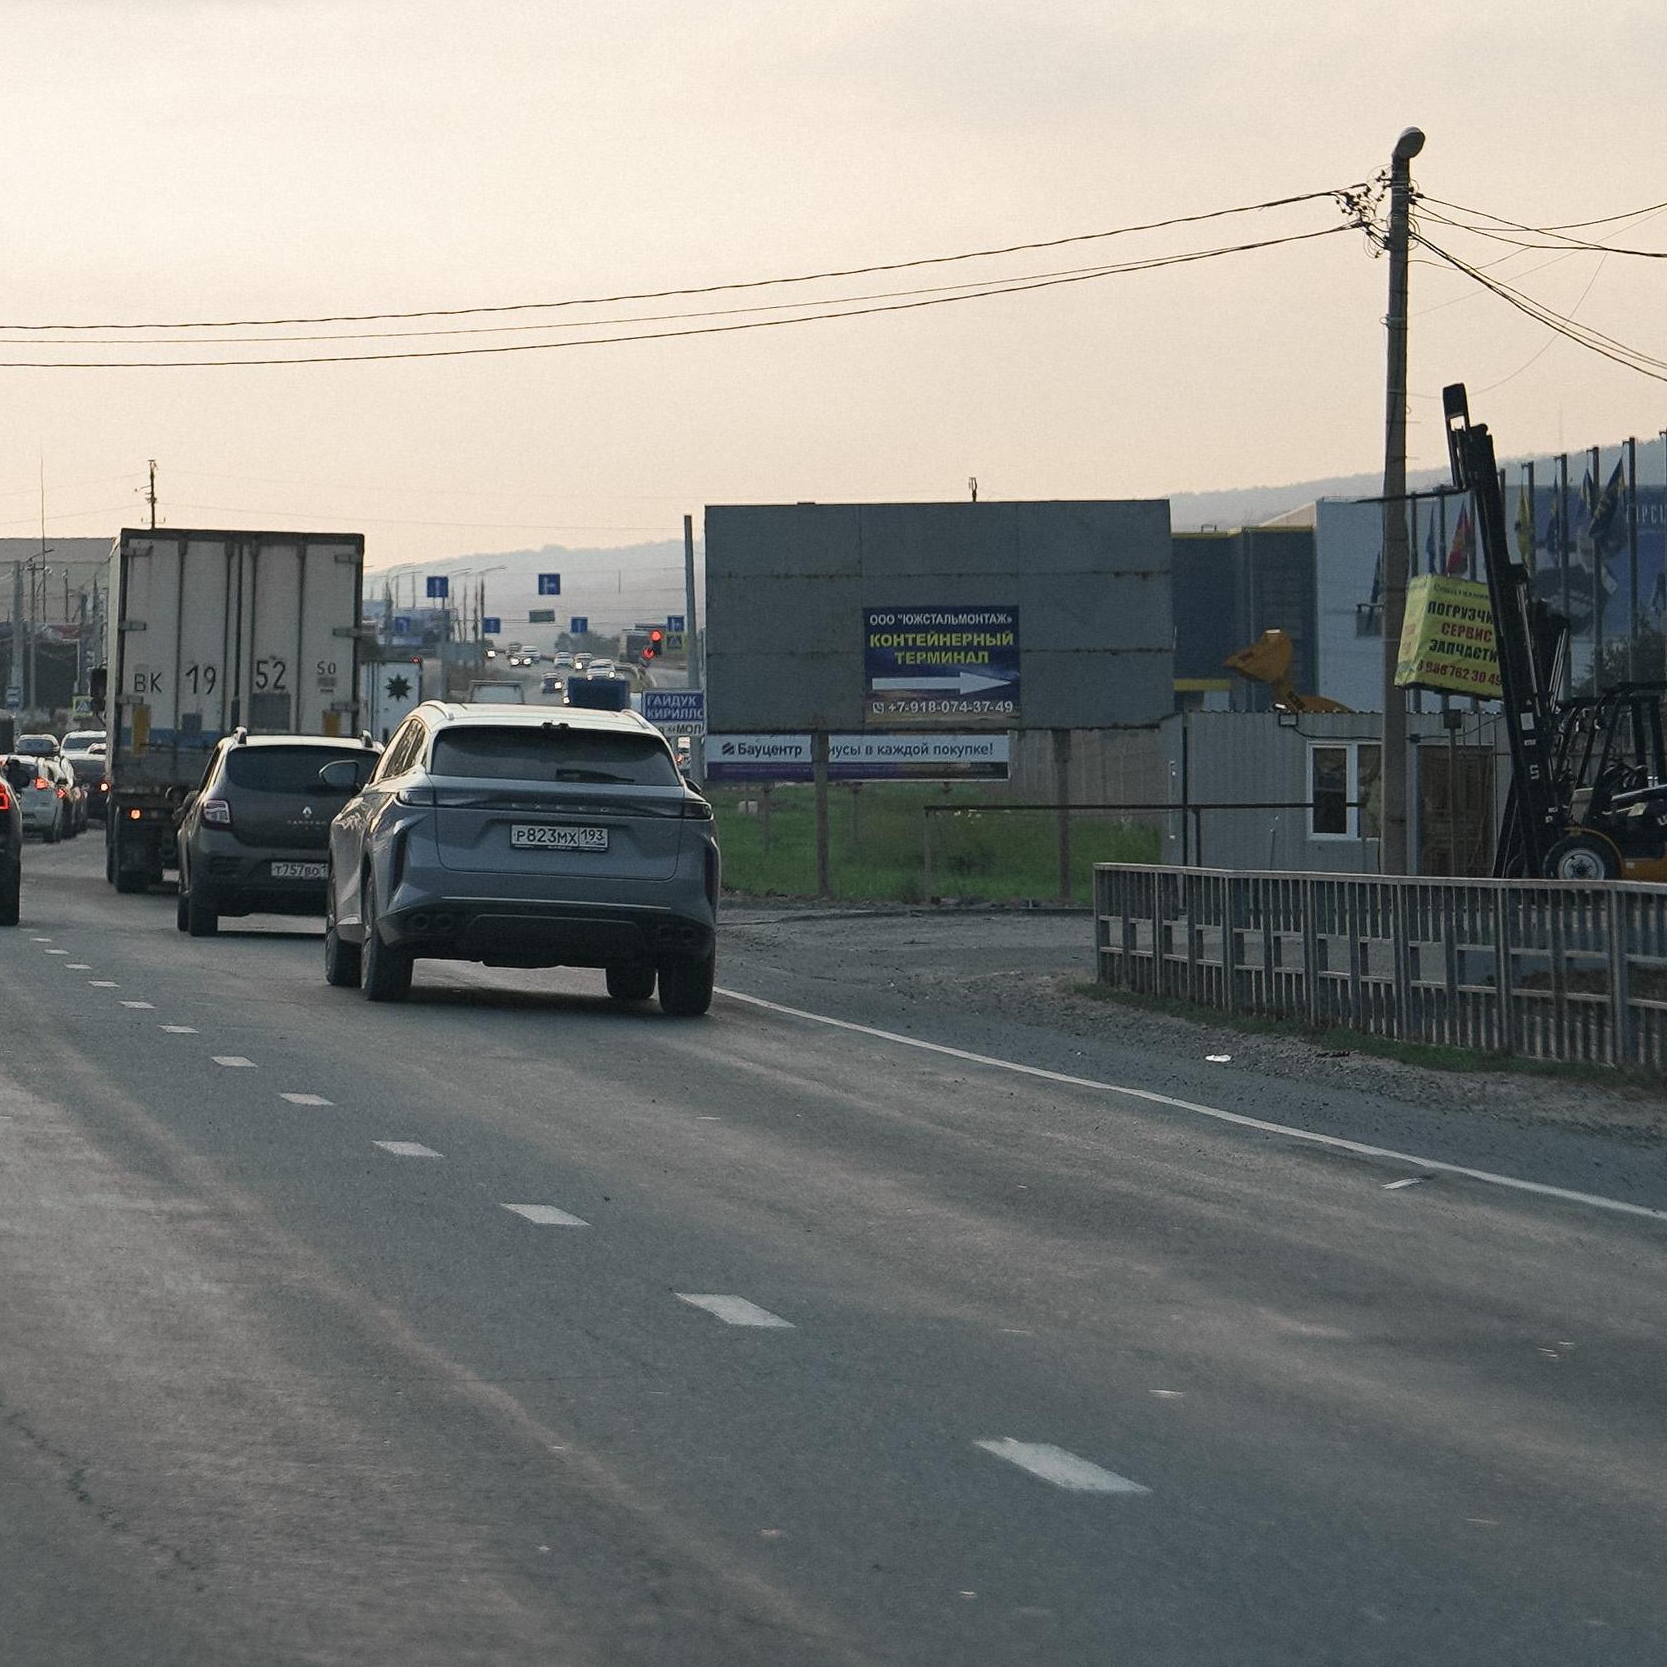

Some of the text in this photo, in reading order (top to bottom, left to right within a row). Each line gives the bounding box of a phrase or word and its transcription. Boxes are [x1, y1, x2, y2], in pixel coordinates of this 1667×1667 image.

[869, 614, 895, 626] ООО
[869, 631, 1014, 647] КОНТЕЙНЕРНЫЙ
[1441, 621, 1493, 643] СЕРВИС
[894, 651, 989, 665] ТЕРМИНАЛ
[1429, 638, 1499, 664] ЗАПЧАСТИ
[185, 665, 217, 695] 19
[255, 659, 287, 690] 52
[888, 700, 1013, 714] +7-918-074-37-49
[737, 741, 803, 758] Бауцентр
[877, 742, 930, 756] каждой
[933, 742, 995, 758] покупке!
[580, 829, 605, 841] 193
